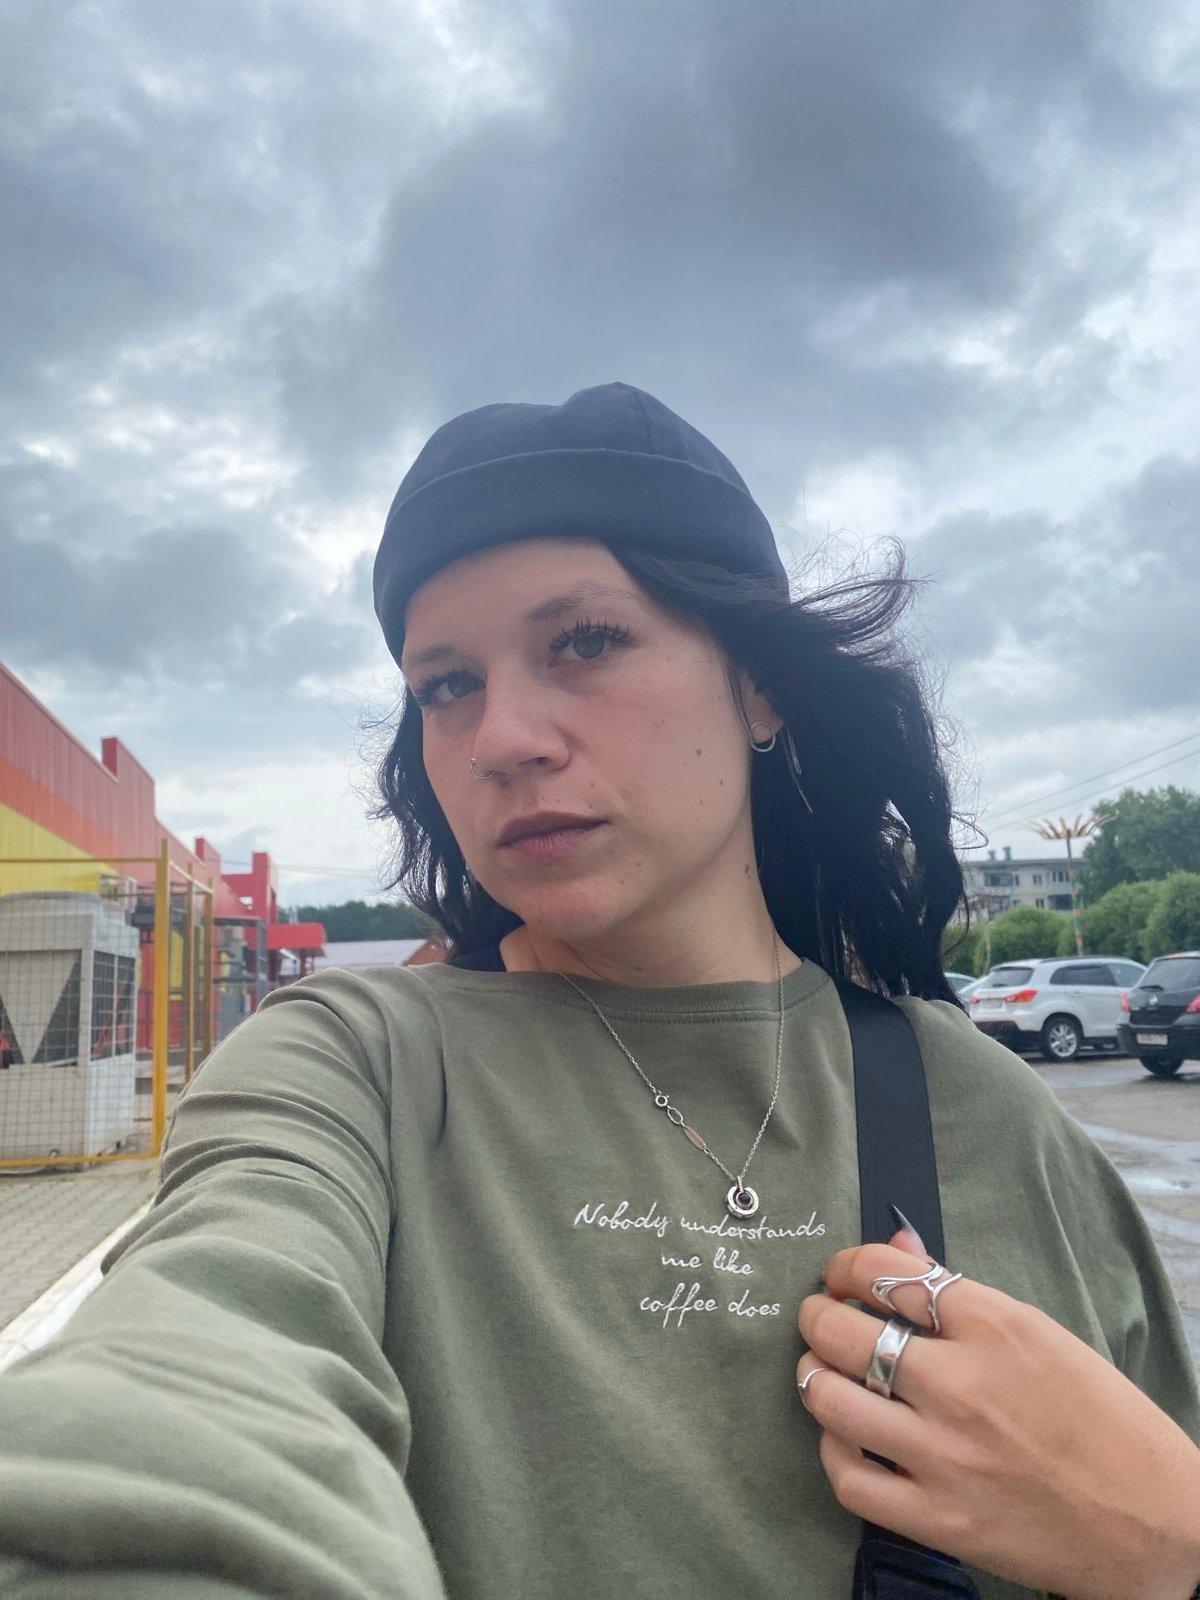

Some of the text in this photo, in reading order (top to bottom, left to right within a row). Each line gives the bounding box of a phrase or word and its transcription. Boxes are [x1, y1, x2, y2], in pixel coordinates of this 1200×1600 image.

[573, 1201, 827, 1240] Nobody understands
[661, 1247, 754, 1276] me like
[640, 1282, 781, 1328] coffee does
